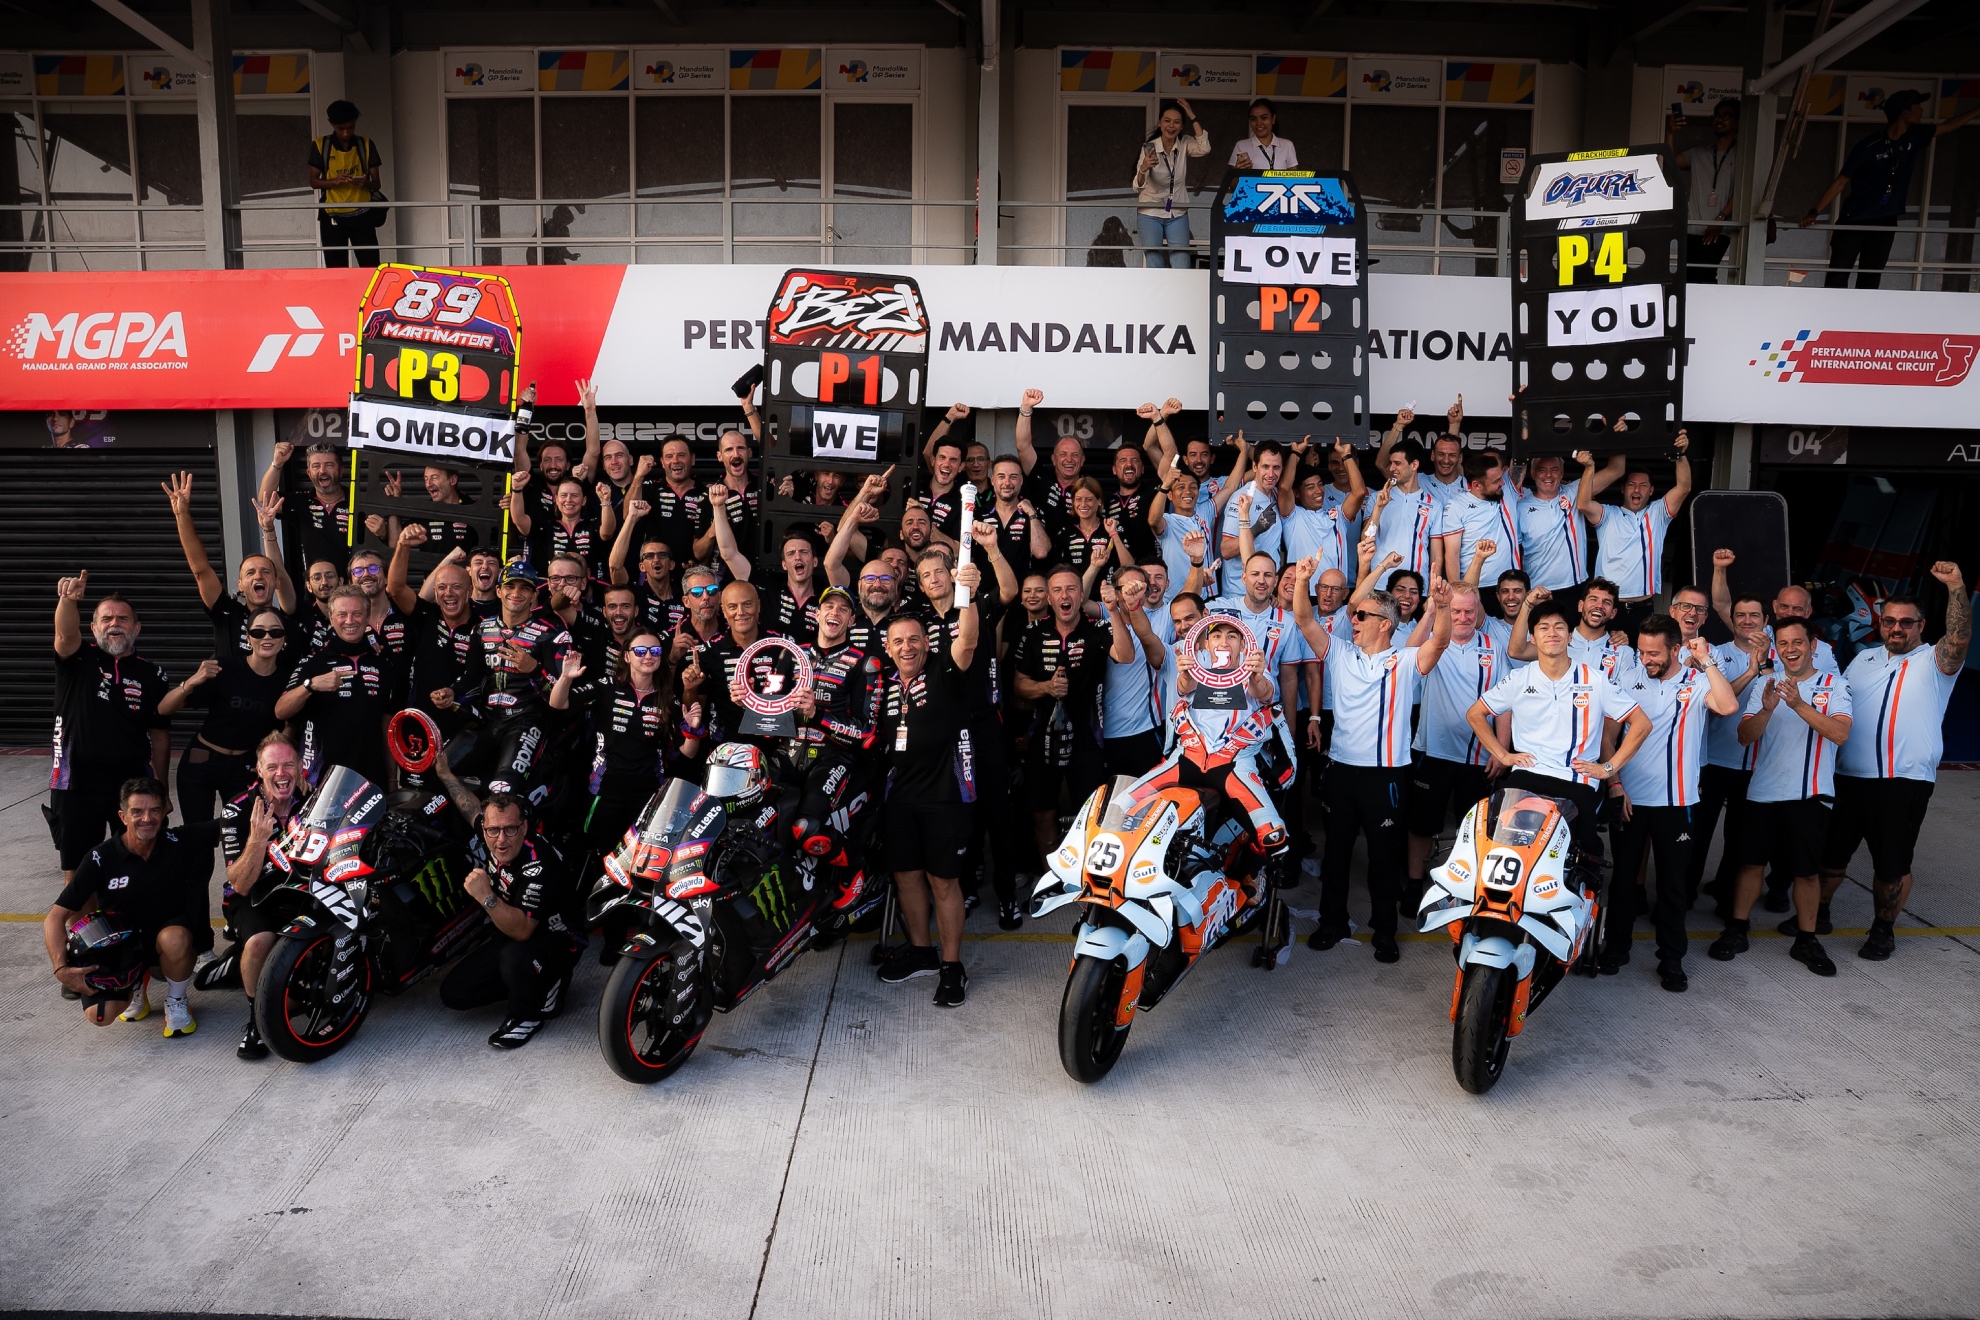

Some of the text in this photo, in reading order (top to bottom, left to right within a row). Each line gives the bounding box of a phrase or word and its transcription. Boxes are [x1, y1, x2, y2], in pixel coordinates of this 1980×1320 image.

[1395, 75, 1431, 83] Mandalika
[1577, 150, 1620, 160] TRACKHOUSE
[1544, 170, 1641, 206] OGURA
[1261, 225, 1318, 233] FERNANDEZ
[1233, 245, 1352, 276] LOVE
[1558, 232, 1628, 286] P4
[844, 278, 857, 286] 72
[393, 279, 483, 325] 89
[778, 285, 925, 335] BEZ
[1259, 287, 1321, 331] P2
[1554, 302, 1657, 335] YOU
[23, 311, 188, 359] MGPA
[383, 322, 494, 349] MARTINATOR
[938, 321, 1197, 355] MANDALIKA
[1811, 347, 1939, 360] PERTAMINA MANDALIKA
[22, 361, 188, 371] MANDALIKA GRAND PRIX ASSOCIATION
[400, 348, 460, 402] P3
[1810, 359, 1936, 372] INTERNATIONAL CIRCUIT
[820, 352, 881, 405] P1
[307, 413, 342, 438] 02
[351, 413, 515, 459] LOMBOK
[814, 422, 878, 450] WE
[1057, 414, 1094, 440] 03
[1787, 431, 1822, 455] 04
[964, 502, 976, 512] 72
[383, 622, 405, 632] aprilia
[359, 665, 380, 674] aprilia
[814, 689, 832, 702] ilia
[818, 681, 837, 689] TARGA
[829, 720, 862, 740] aprilia
[53, 715, 63, 769] aprilia
[303, 720, 315, 769] aprilia
[512, 726, 542, 774] aprilia
[958, 729, 972, 782] aprilia
[823, 765, 847, 795] aprilia
[423, 793, 447, 815] aprilia
[755, 805, 776, 829] aprilia
[335, 830, 361, 842] BS
[677, 844, 704, 857] BS
[1060, 848, 1077, 867] Gulf
[1088, 840, 1121, 872] 25
[328, 860, 358, 880] sterilgarda
[1132, 866, 1158, 879] Gulf
[1448, 862, 1470, 881] Gulf
[1486, 854, 1522, 886] 79
[108, 876, 129, 890] 89
[347, 880, 367, 891] sky
[670, 876, 703, 897] sterilgarda
[1533, 881, 1559, 894] Gulf
[692, 897, 711, 910] sky
